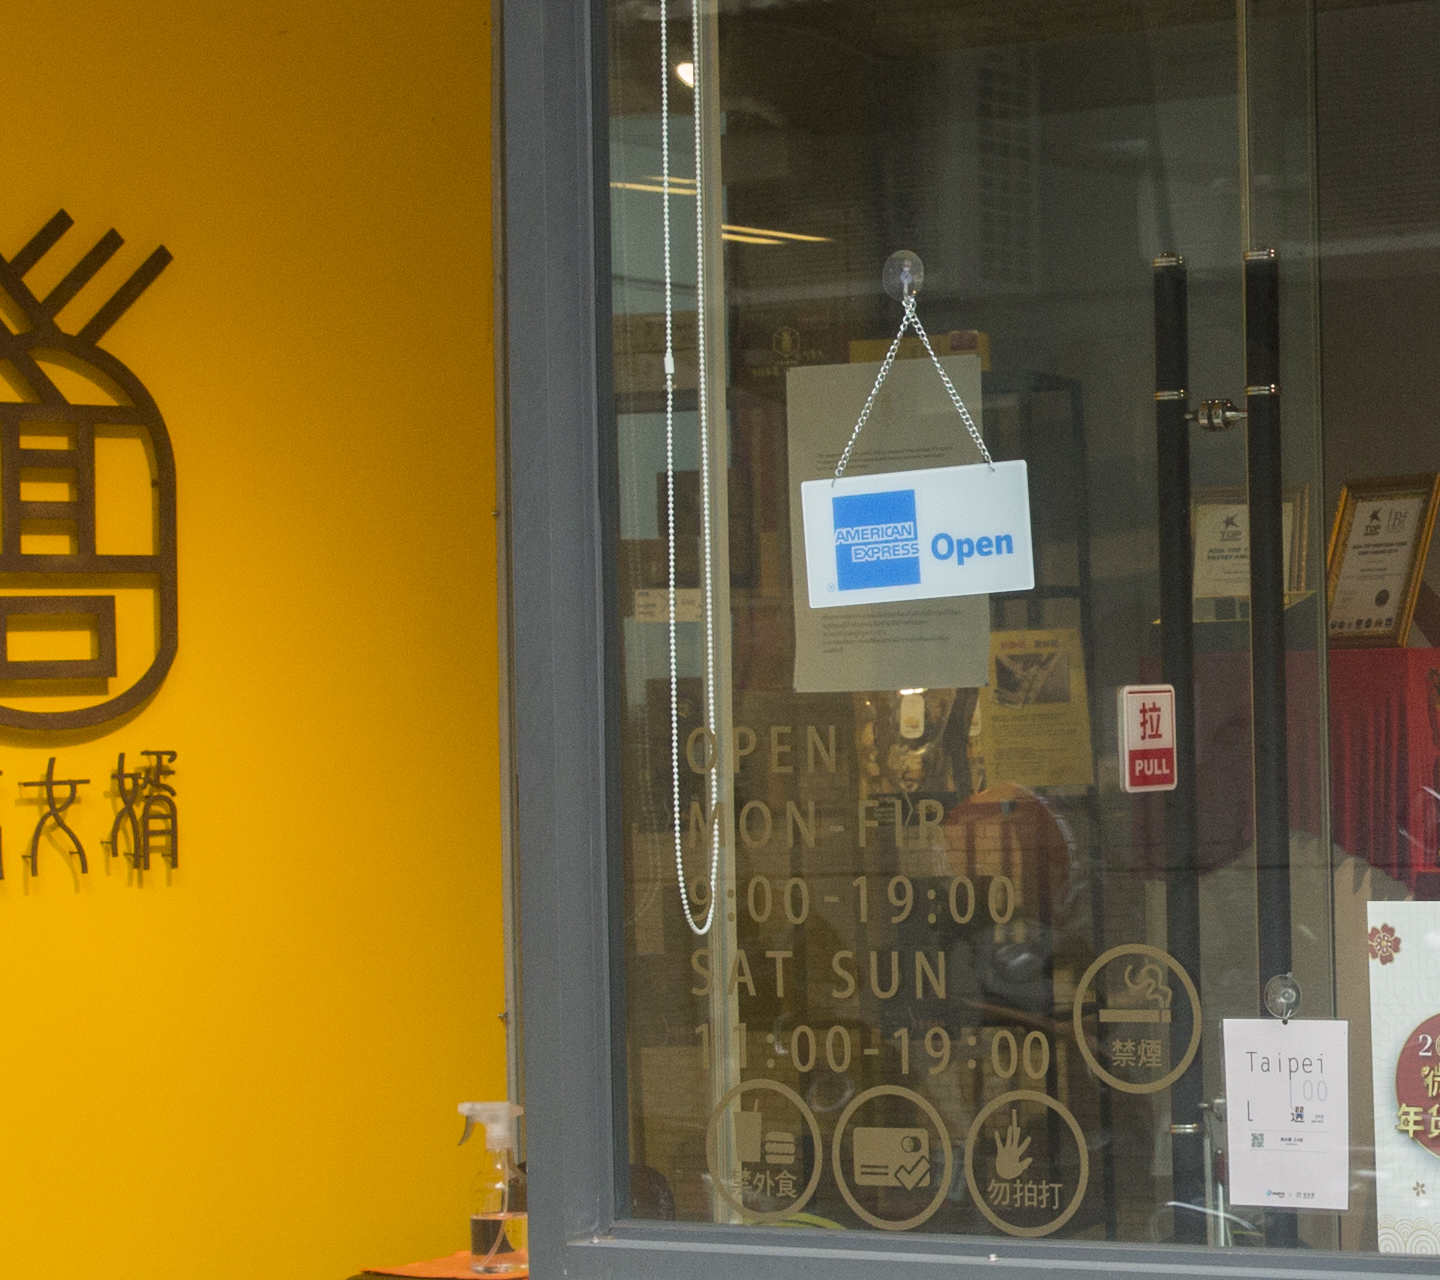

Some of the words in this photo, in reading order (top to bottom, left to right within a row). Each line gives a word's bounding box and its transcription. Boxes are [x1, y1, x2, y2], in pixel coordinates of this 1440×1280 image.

[835, 523, 912, 543] AMERICAN
[931, 532, 1014, 566] Open
[853, 543, 920, 561] EXPRESS
[1140, 702, 1163, 741] 拉
[685, 725, 837, 775] OPEN
[1135, 758, 1171, 777] PULL
[690, 875, 1016, 925] 9:00-19:00
[691, 949, 795, 998] SAT
[831, 950, 948, 1000] SUN
[694, 1024, 1051, 1080] 11:00-19:00
[1111, 1039, 1163, 1068] 禁煙
[1246, 1051, 1324, 1081] Taipei
[986, 1178, 1064, 1210] 勿拍打
